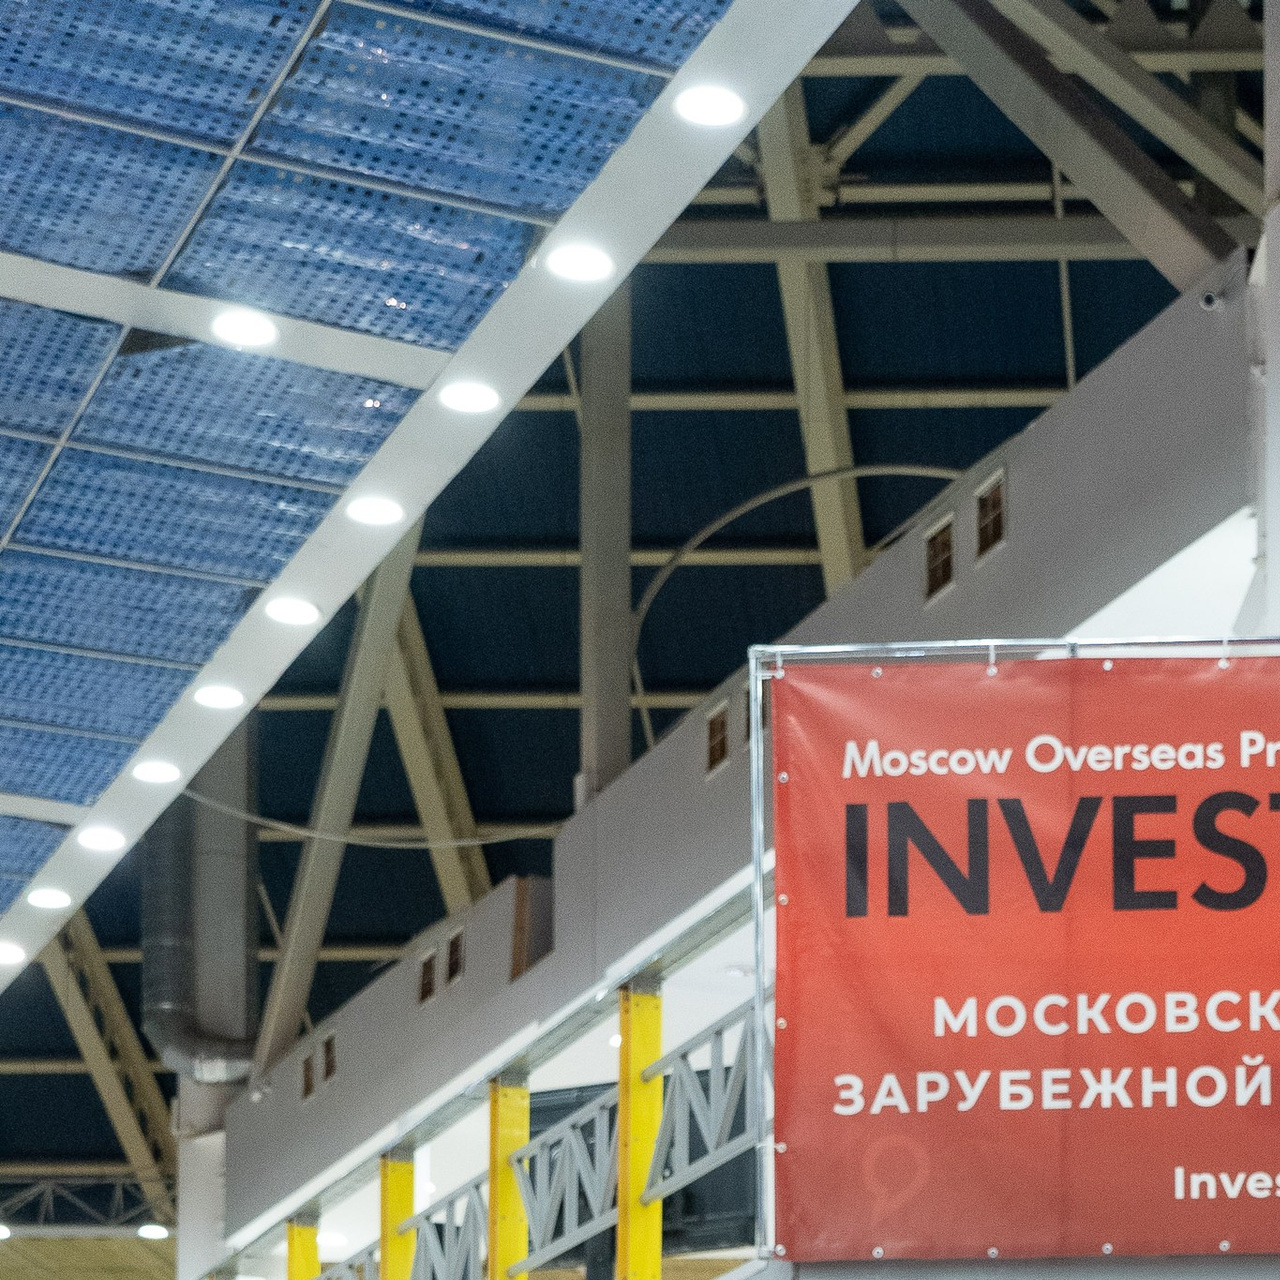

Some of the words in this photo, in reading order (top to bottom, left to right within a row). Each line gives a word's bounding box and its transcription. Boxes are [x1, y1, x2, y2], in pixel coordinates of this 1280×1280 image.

[842, 740, 1011, 778] Moscow
[1026, 731, 1225, 774] Overseas
[833, 1057, 1273, 1115] ЗАРУБЕЖНОЙ
